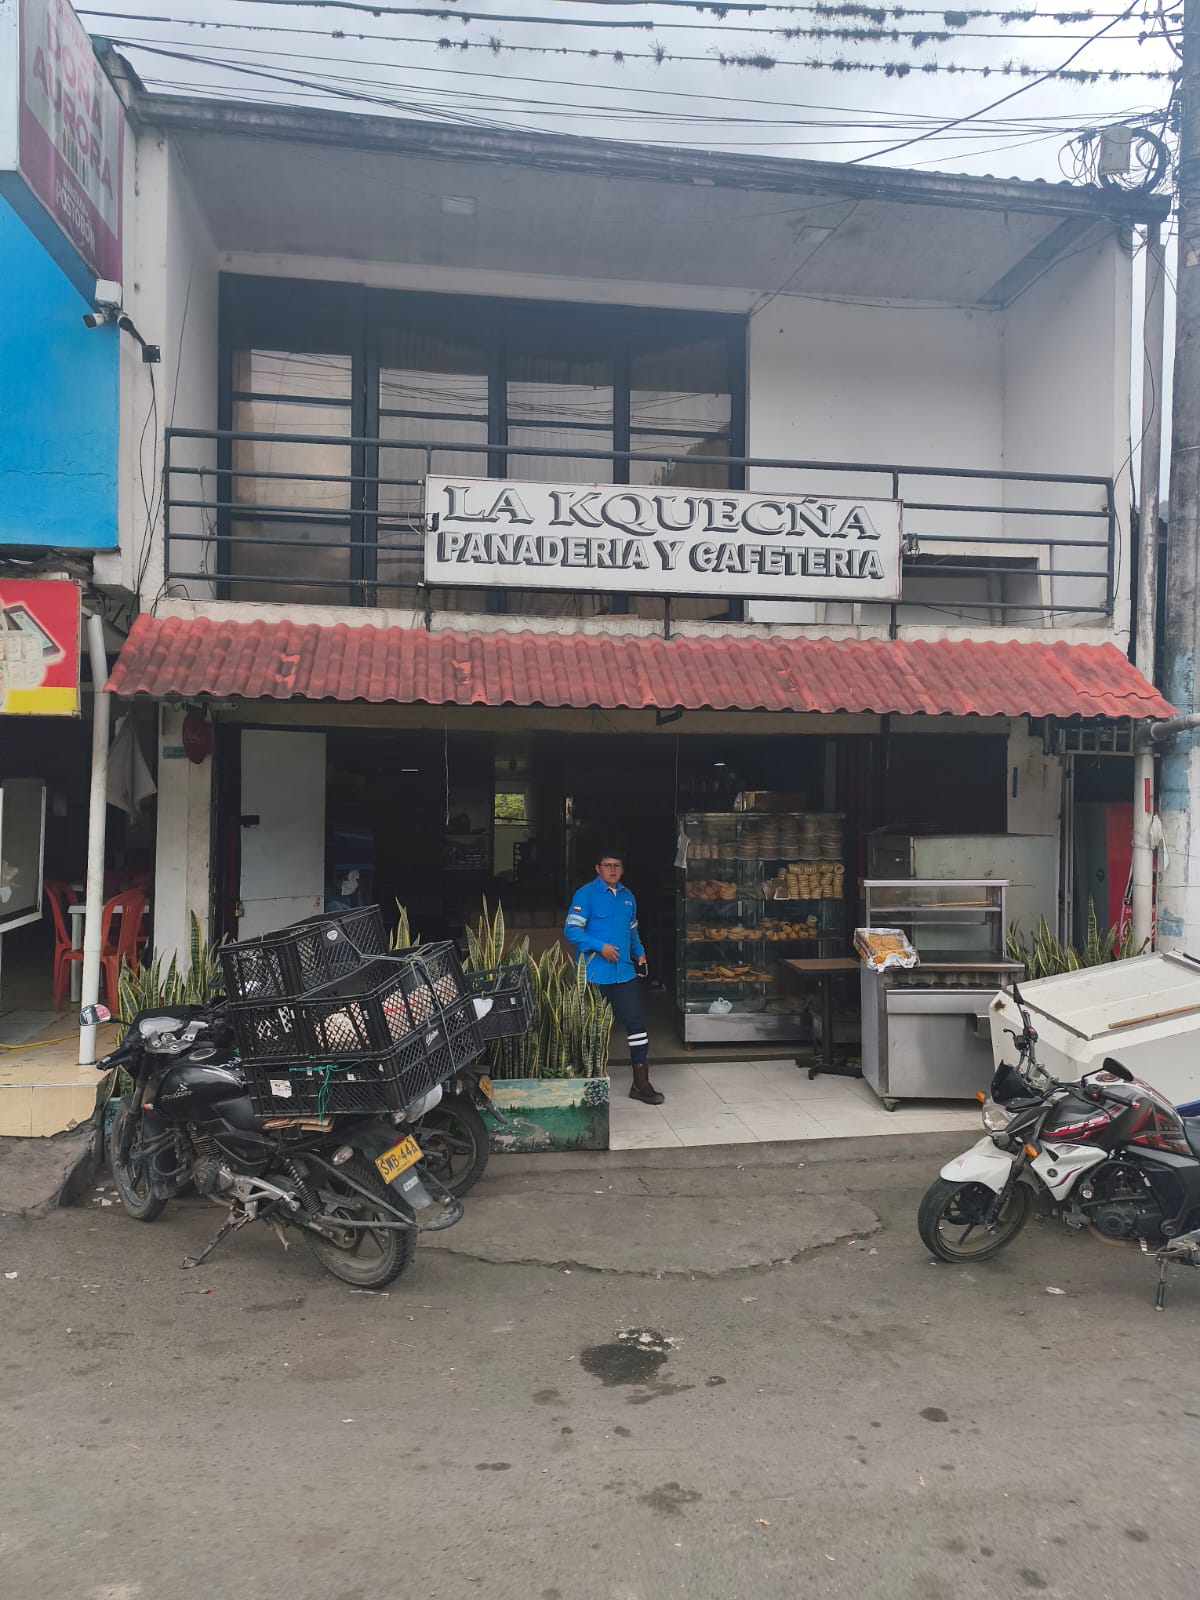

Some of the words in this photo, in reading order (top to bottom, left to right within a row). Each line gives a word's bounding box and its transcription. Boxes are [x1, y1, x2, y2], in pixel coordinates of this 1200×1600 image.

[47, 12, 103, 139] DOÑA
[33, 46, 113, 201] AURORA
[437, 531, 650, 569] PANADERIA
[653, 540, 685, 571] Y
[689, 541, 884, 579] CAFETERIA
[443, 485, 535, 525] LA
[549, 491, 880, 540] KQUECÑA
